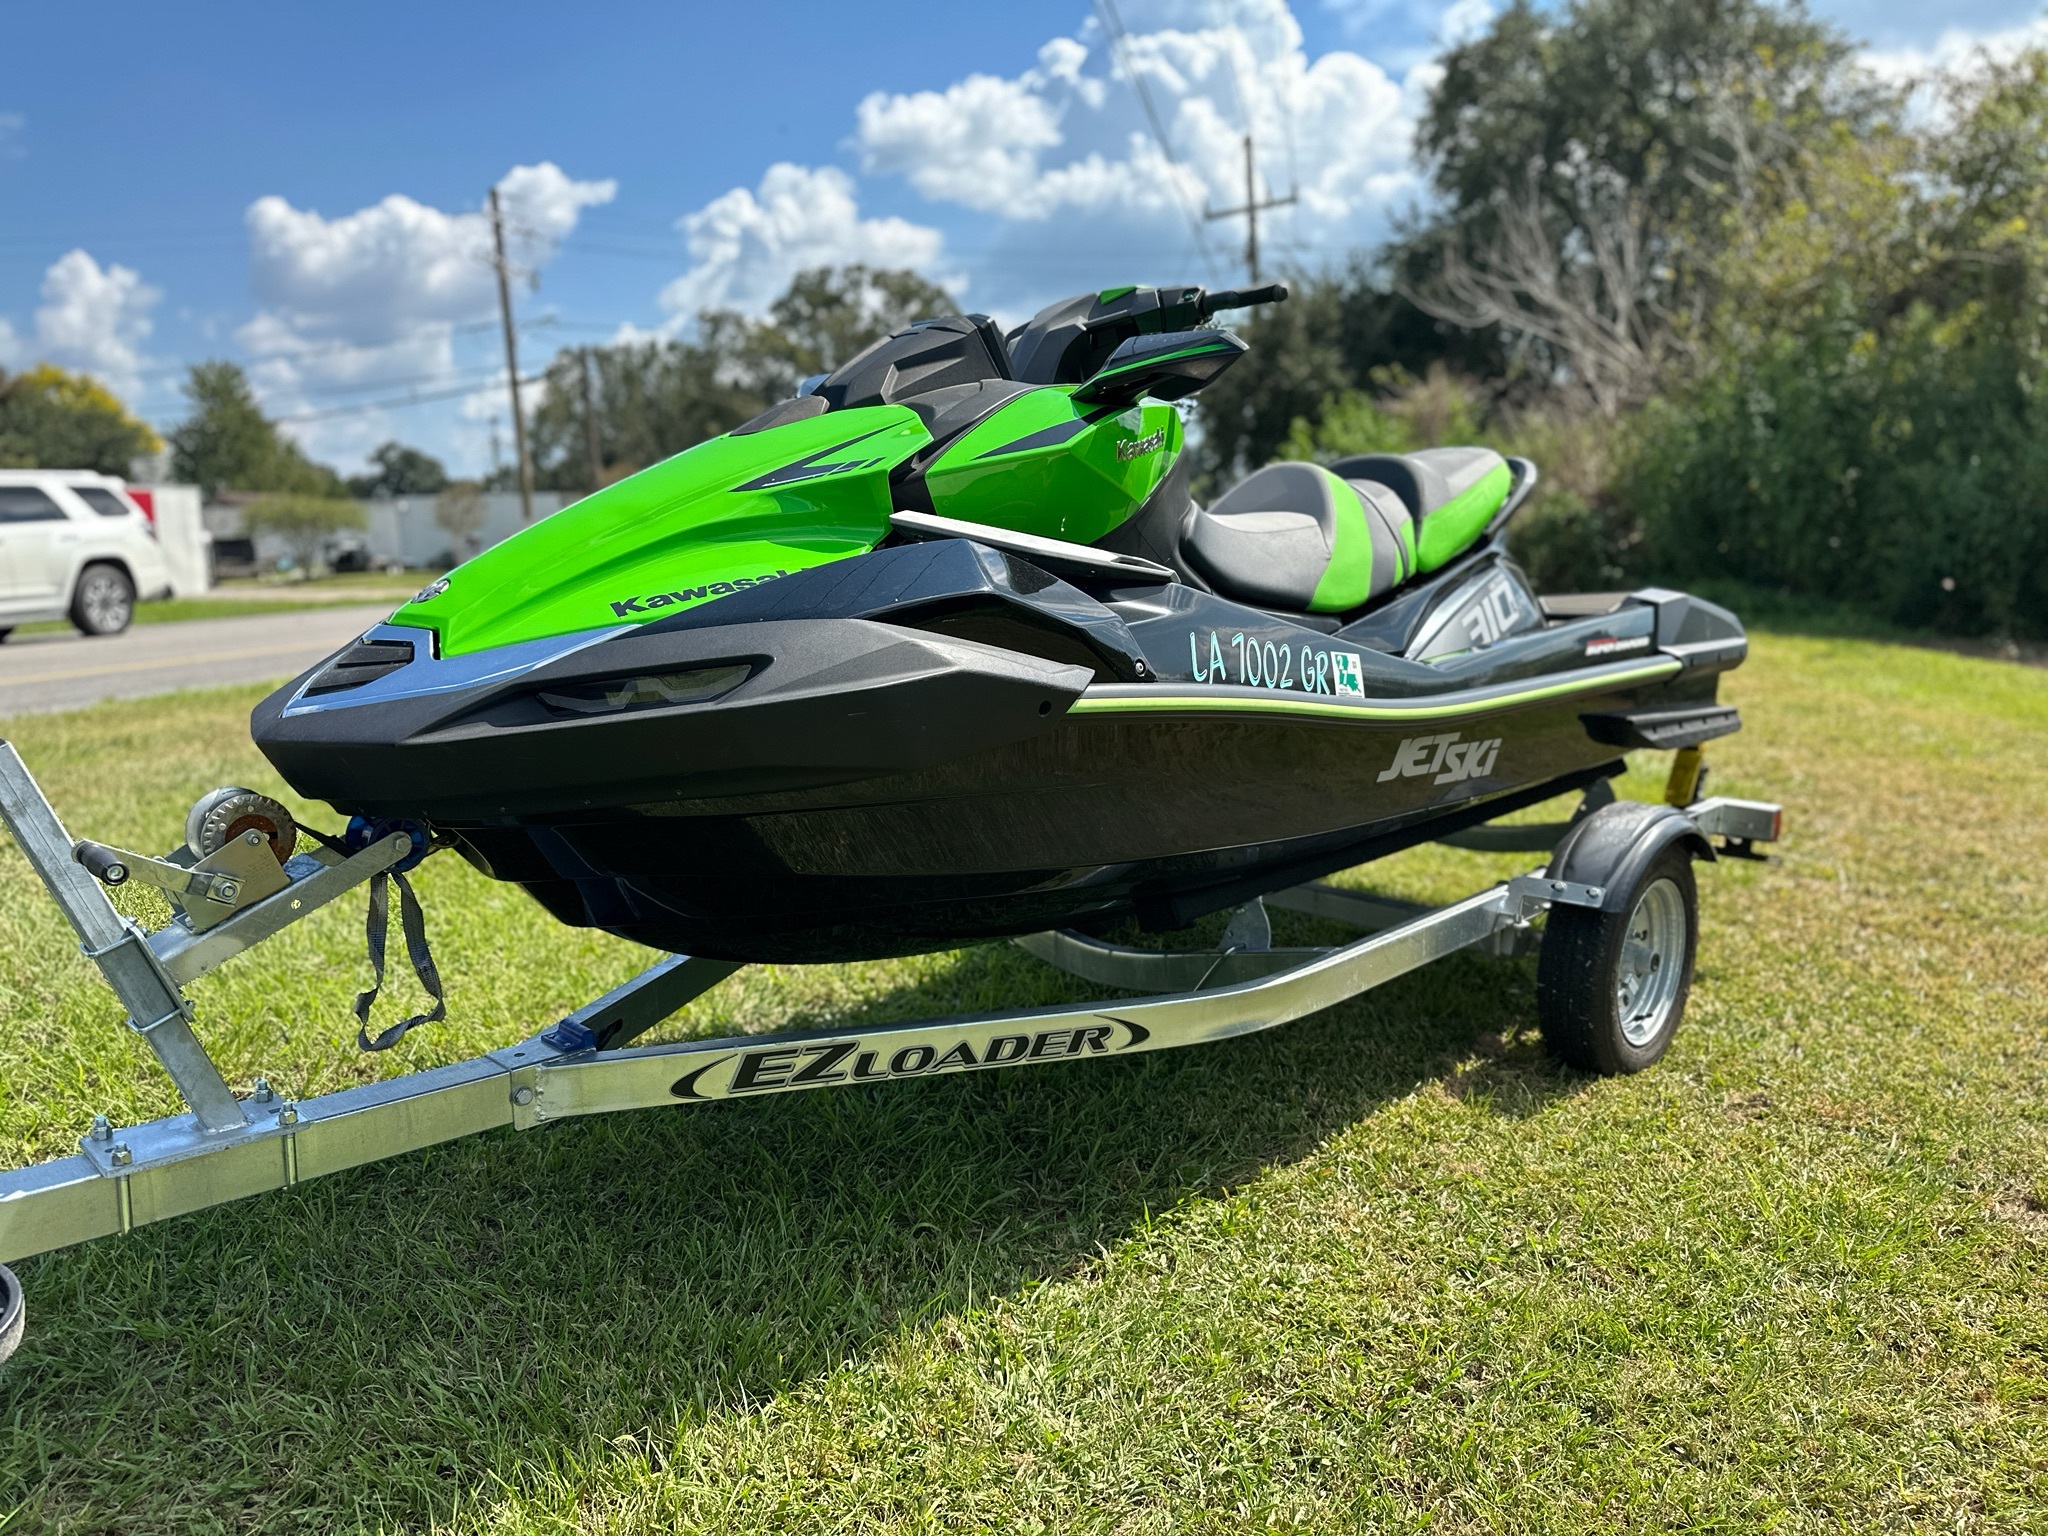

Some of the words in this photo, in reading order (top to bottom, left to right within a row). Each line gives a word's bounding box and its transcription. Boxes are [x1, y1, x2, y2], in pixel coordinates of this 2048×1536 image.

[1116, 426, 1165, 463] Kawasaki
[610, 567, 812, 618] Kawas
[1461, 580, 1520, 645] 310
[1189, 630, 1227, 685] LA
[1301, 645, 1330, 695] GR
